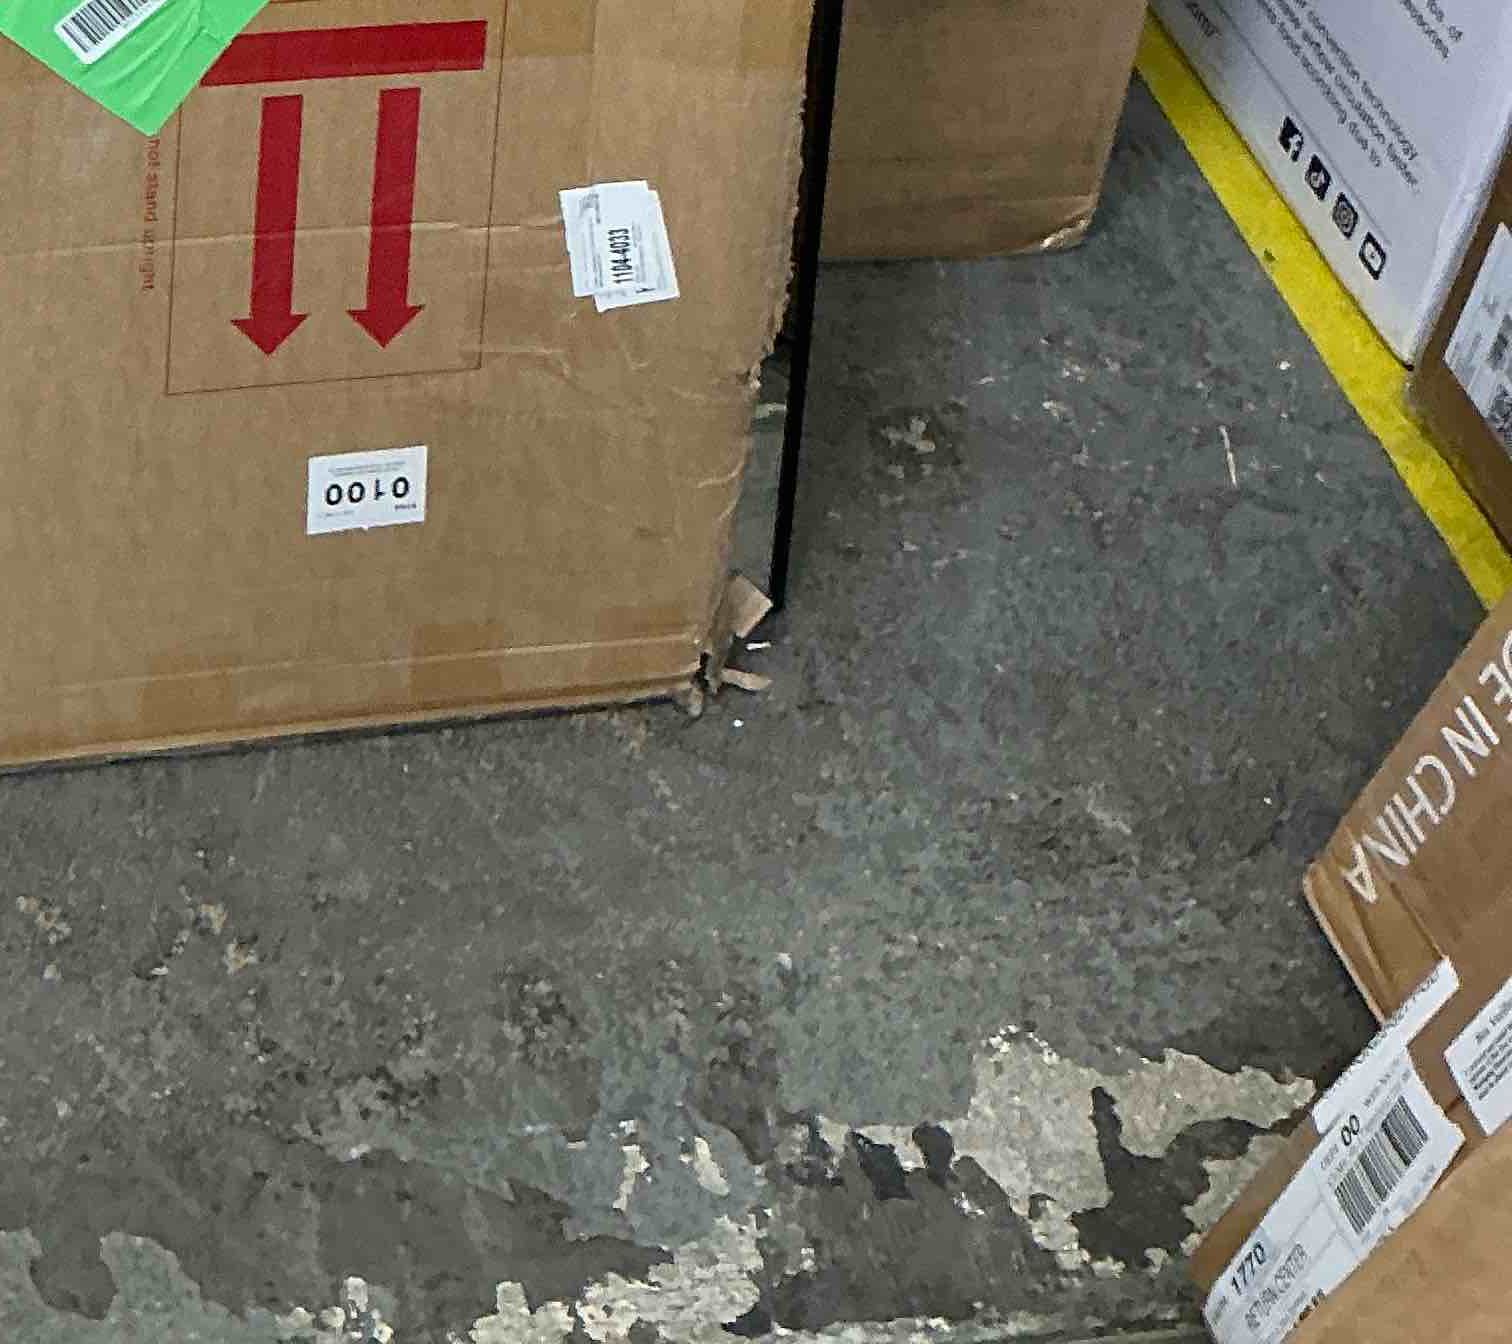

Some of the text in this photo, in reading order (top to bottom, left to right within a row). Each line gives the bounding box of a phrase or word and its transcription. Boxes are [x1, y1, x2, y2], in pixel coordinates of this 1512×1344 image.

[606, 227, 634, 284] 1104-4033
[324, 476, 410, 506] 0100
[1440, 695, 1500, 777] IN
[1340, 754, 1456, 904] CHINA
[1230, 1239, 1267, 1296] 1770
